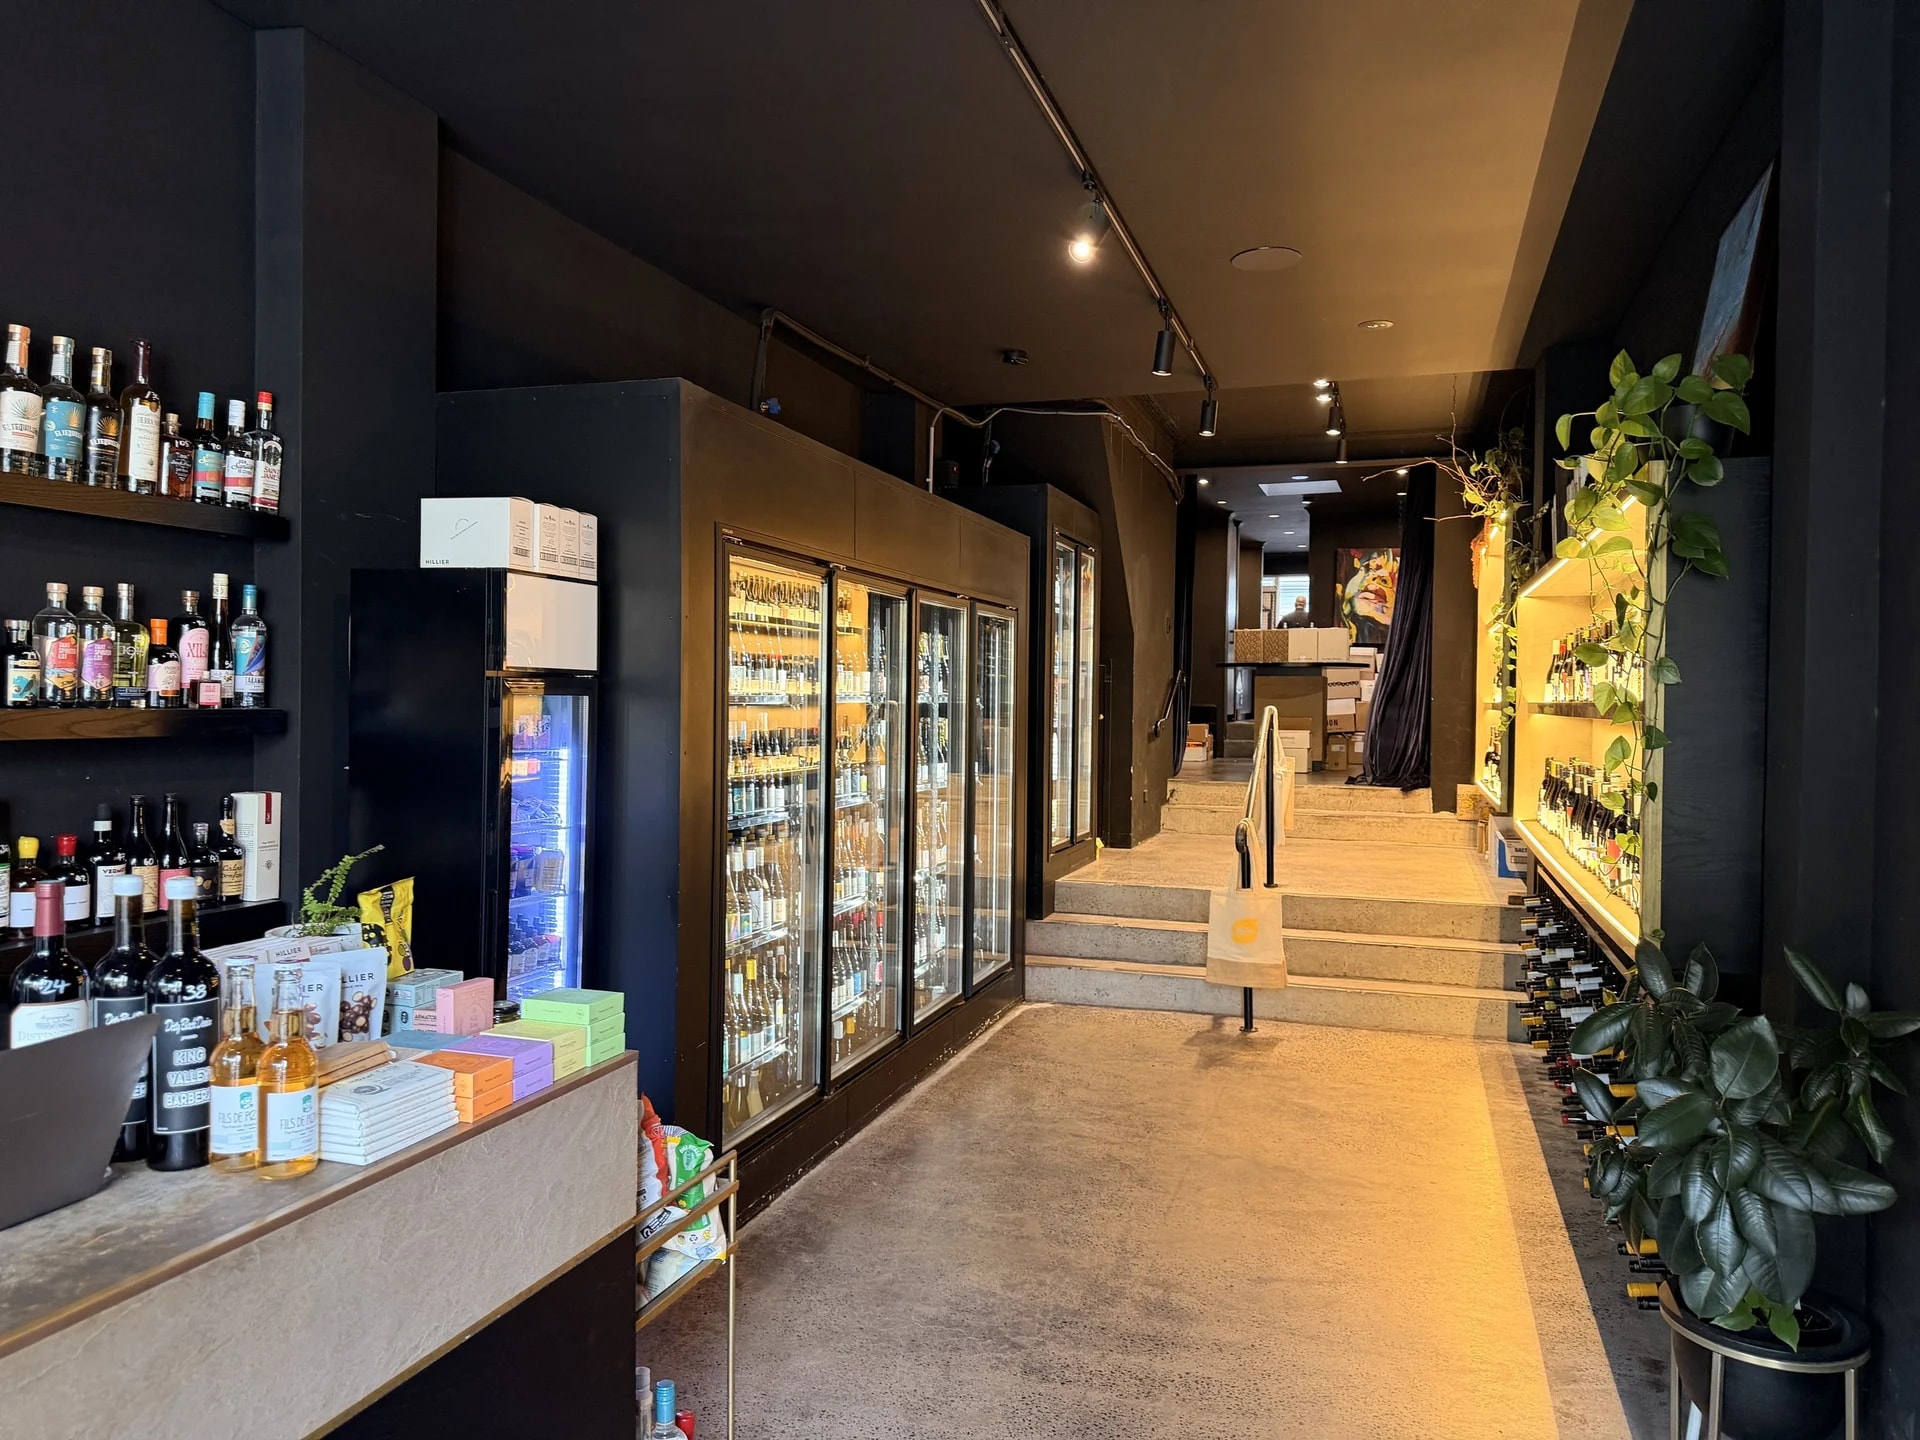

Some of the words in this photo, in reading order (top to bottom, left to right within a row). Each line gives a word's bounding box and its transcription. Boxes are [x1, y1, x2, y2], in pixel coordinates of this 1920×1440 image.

[144, 858, 154, 866] 60
[276, 947, 302, 958] HILLIER
[341, 973, 375, 984] LLIER
[41, 979, 71, 995] 24
[183, 984, 207, 1000] 38
[173, 1047, 206, 1066] KING
